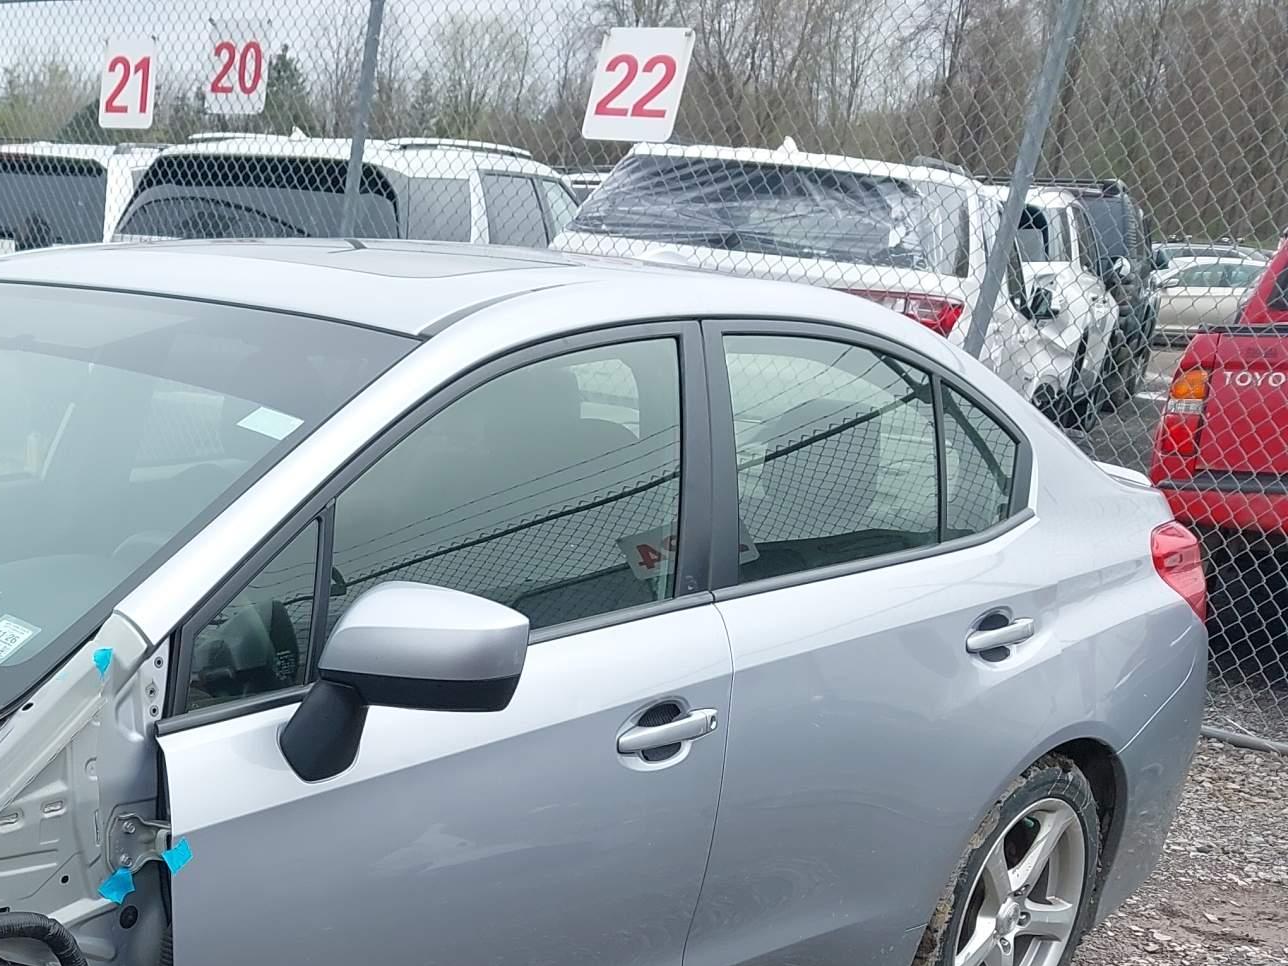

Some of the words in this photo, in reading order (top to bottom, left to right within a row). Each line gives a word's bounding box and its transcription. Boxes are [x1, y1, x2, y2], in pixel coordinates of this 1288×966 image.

[104, 55, 151, 114] 21
[211, 41, 262, 95] 20
[594, 53, 677, 118] 22
[1223, 371, 1287, 388] TOYO
